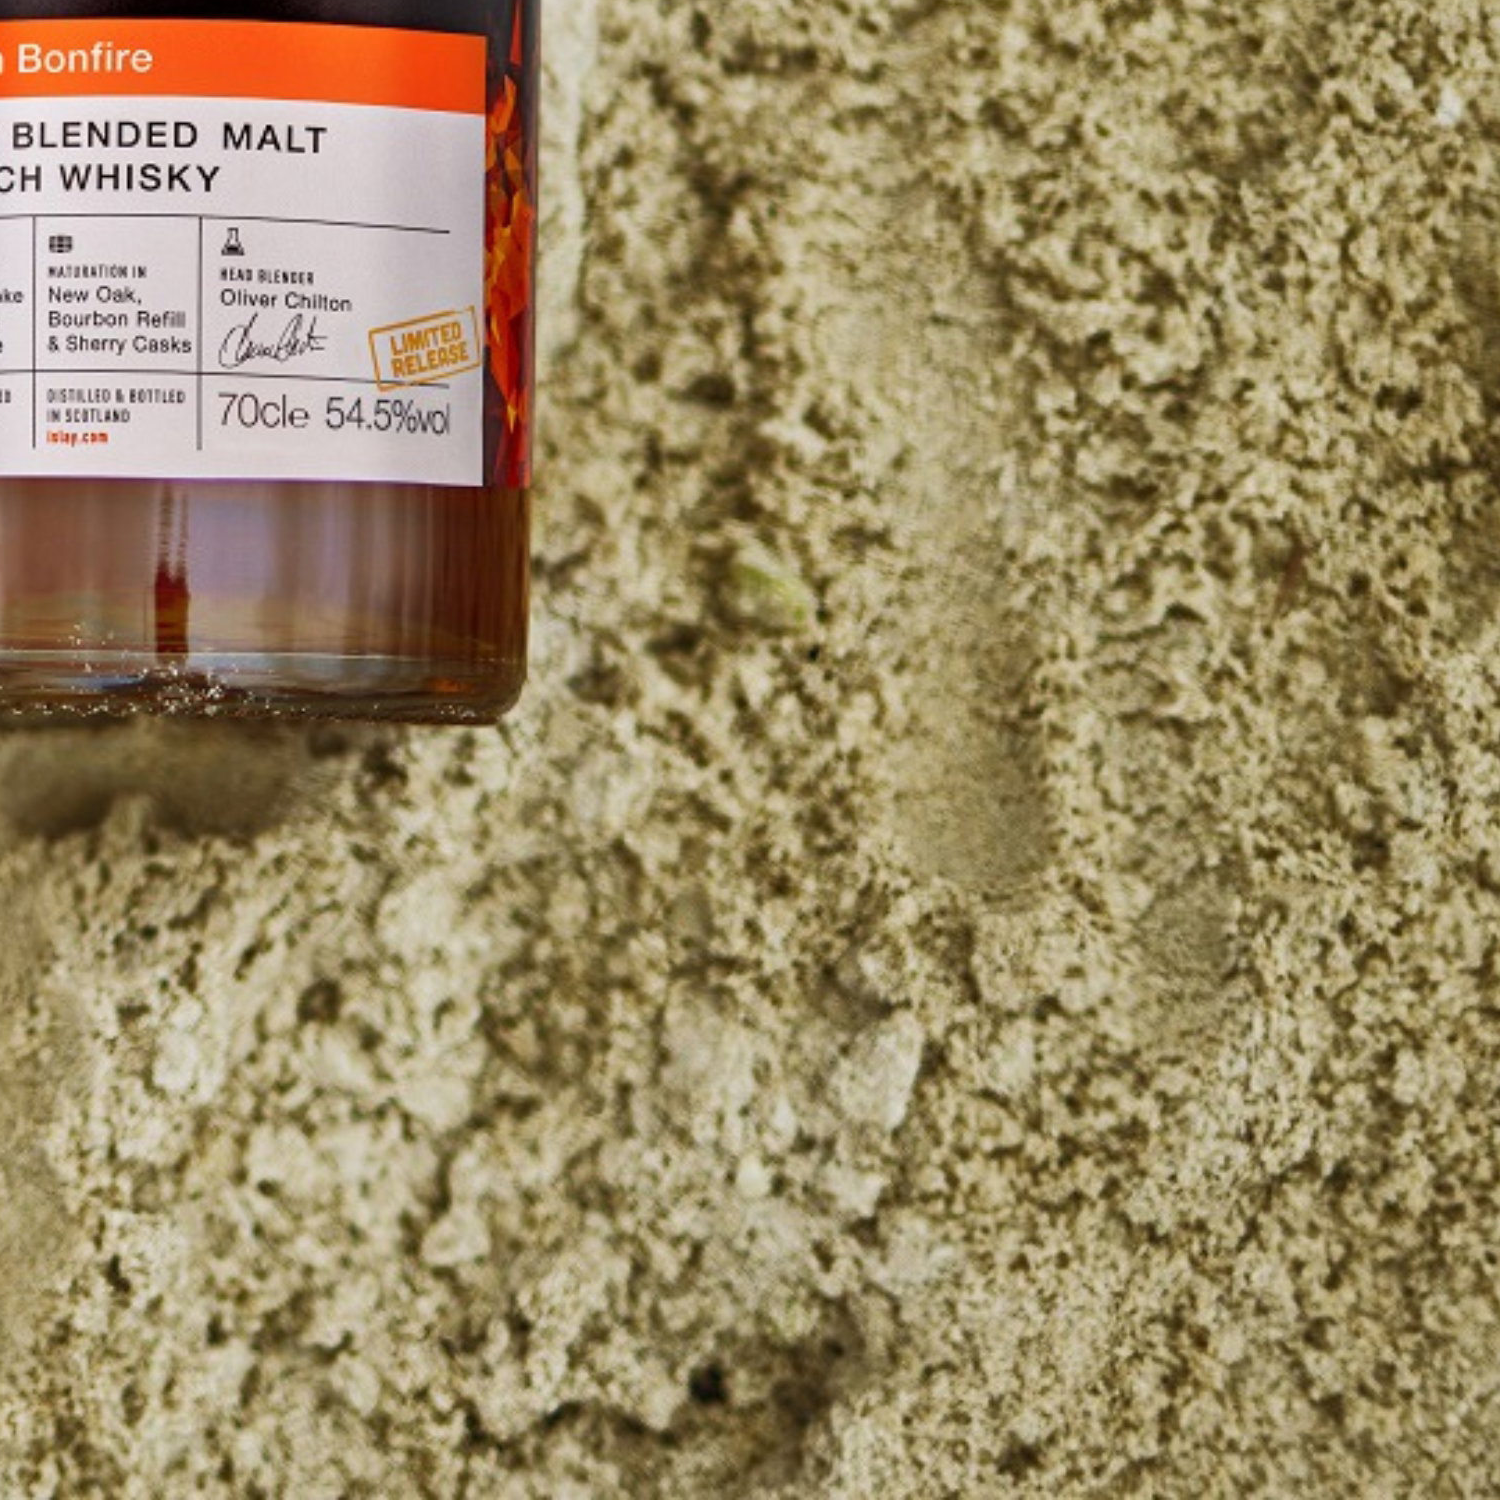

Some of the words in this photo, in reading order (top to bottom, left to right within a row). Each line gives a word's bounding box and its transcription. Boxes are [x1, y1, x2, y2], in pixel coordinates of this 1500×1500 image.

[17, 43, 153, 74] Bonfire
[13, 121, 198, 150] BLENDED
[223, 125, 327, 154] MALT
[59, 163, 221, 194] WHISKY
[48, 264, 127, 278] MATURATION
[132, 266, 147, 278] IN
[220, 269, 252, 282] HEAD
[257, 270, 314, 285] BLENDER
[49, 287, 89, 303] New
[96, 286, 142, 305] Oak,
[221, 289, 277, 308] Oliver
[285, 292, 352, 312] Chilton
[49, 312, 128, 327] Bourbon
[137, 310, 186, 327] Refill
[49, 336, 59, 352] &
[66, 336, 126, 356] Sherry
[133, 336, 192, 354] Casks
[389, 321, 462, 356] LIMITED
[391, 341, 469, 377] RELEASE
[47, 389, 111, 403] DISTILLED
[115, 389, 125, 403] &
[129, 390, 186, 403] BOTTLED
[47, 408, 61, 423] IN
[65, 408, 130, 423] SCOTLAND
[326, 396, 450, 435] 54.5%vol
[46, 431, 108, 446] islay.com
